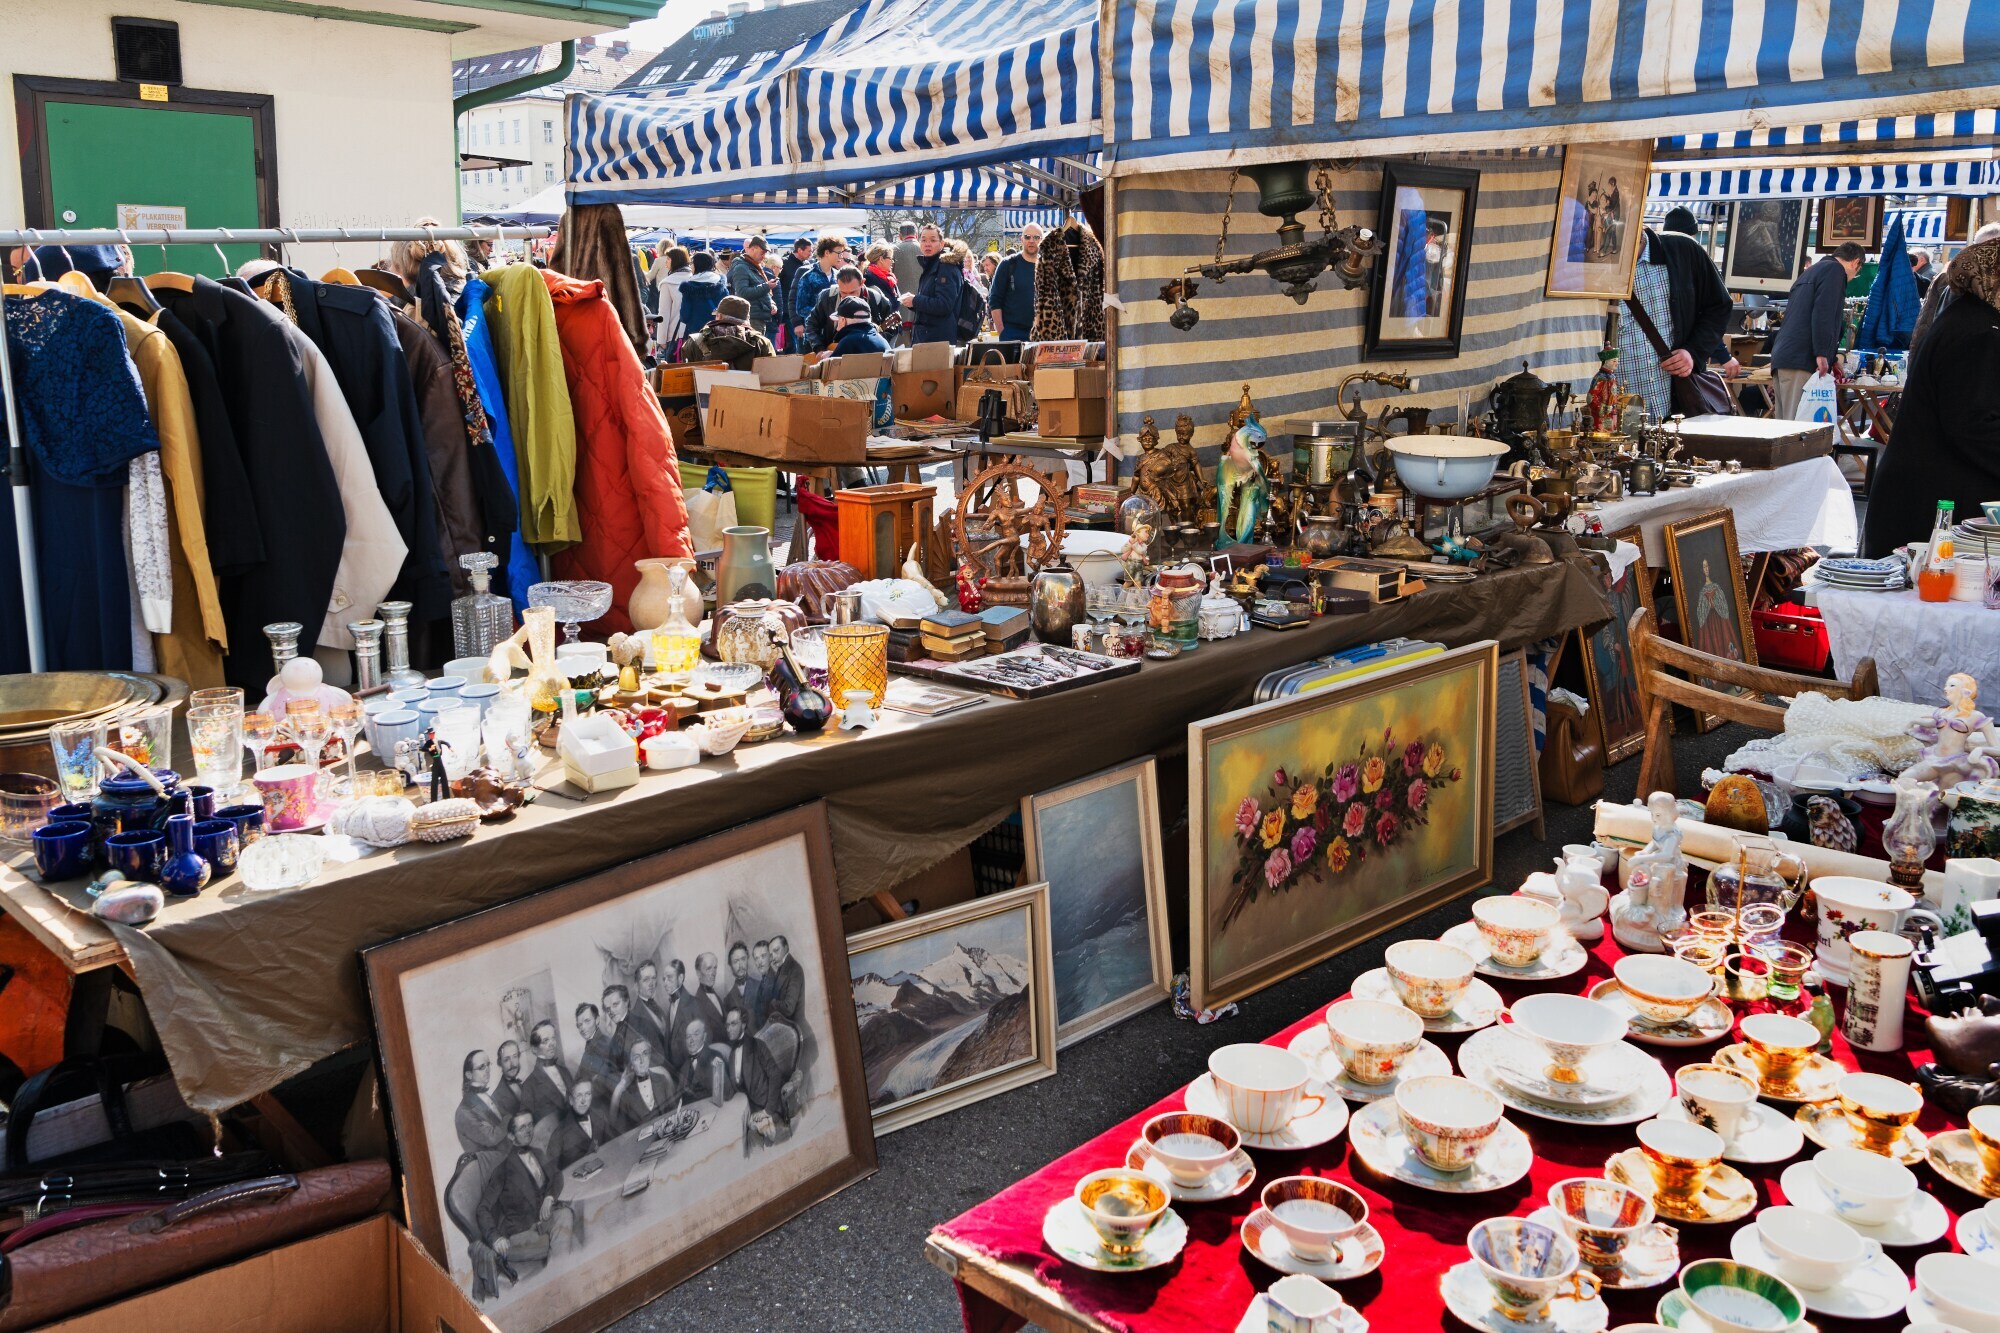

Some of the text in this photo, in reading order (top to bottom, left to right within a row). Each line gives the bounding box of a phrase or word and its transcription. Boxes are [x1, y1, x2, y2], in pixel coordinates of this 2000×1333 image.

[693, 18, 734, 39] conwert
[141, 213, 183, 222] PLAKATIEREN
[146, 222, 177, 230] VERBOTEN
[1055, 344, 1081, 353] PLATTERS
